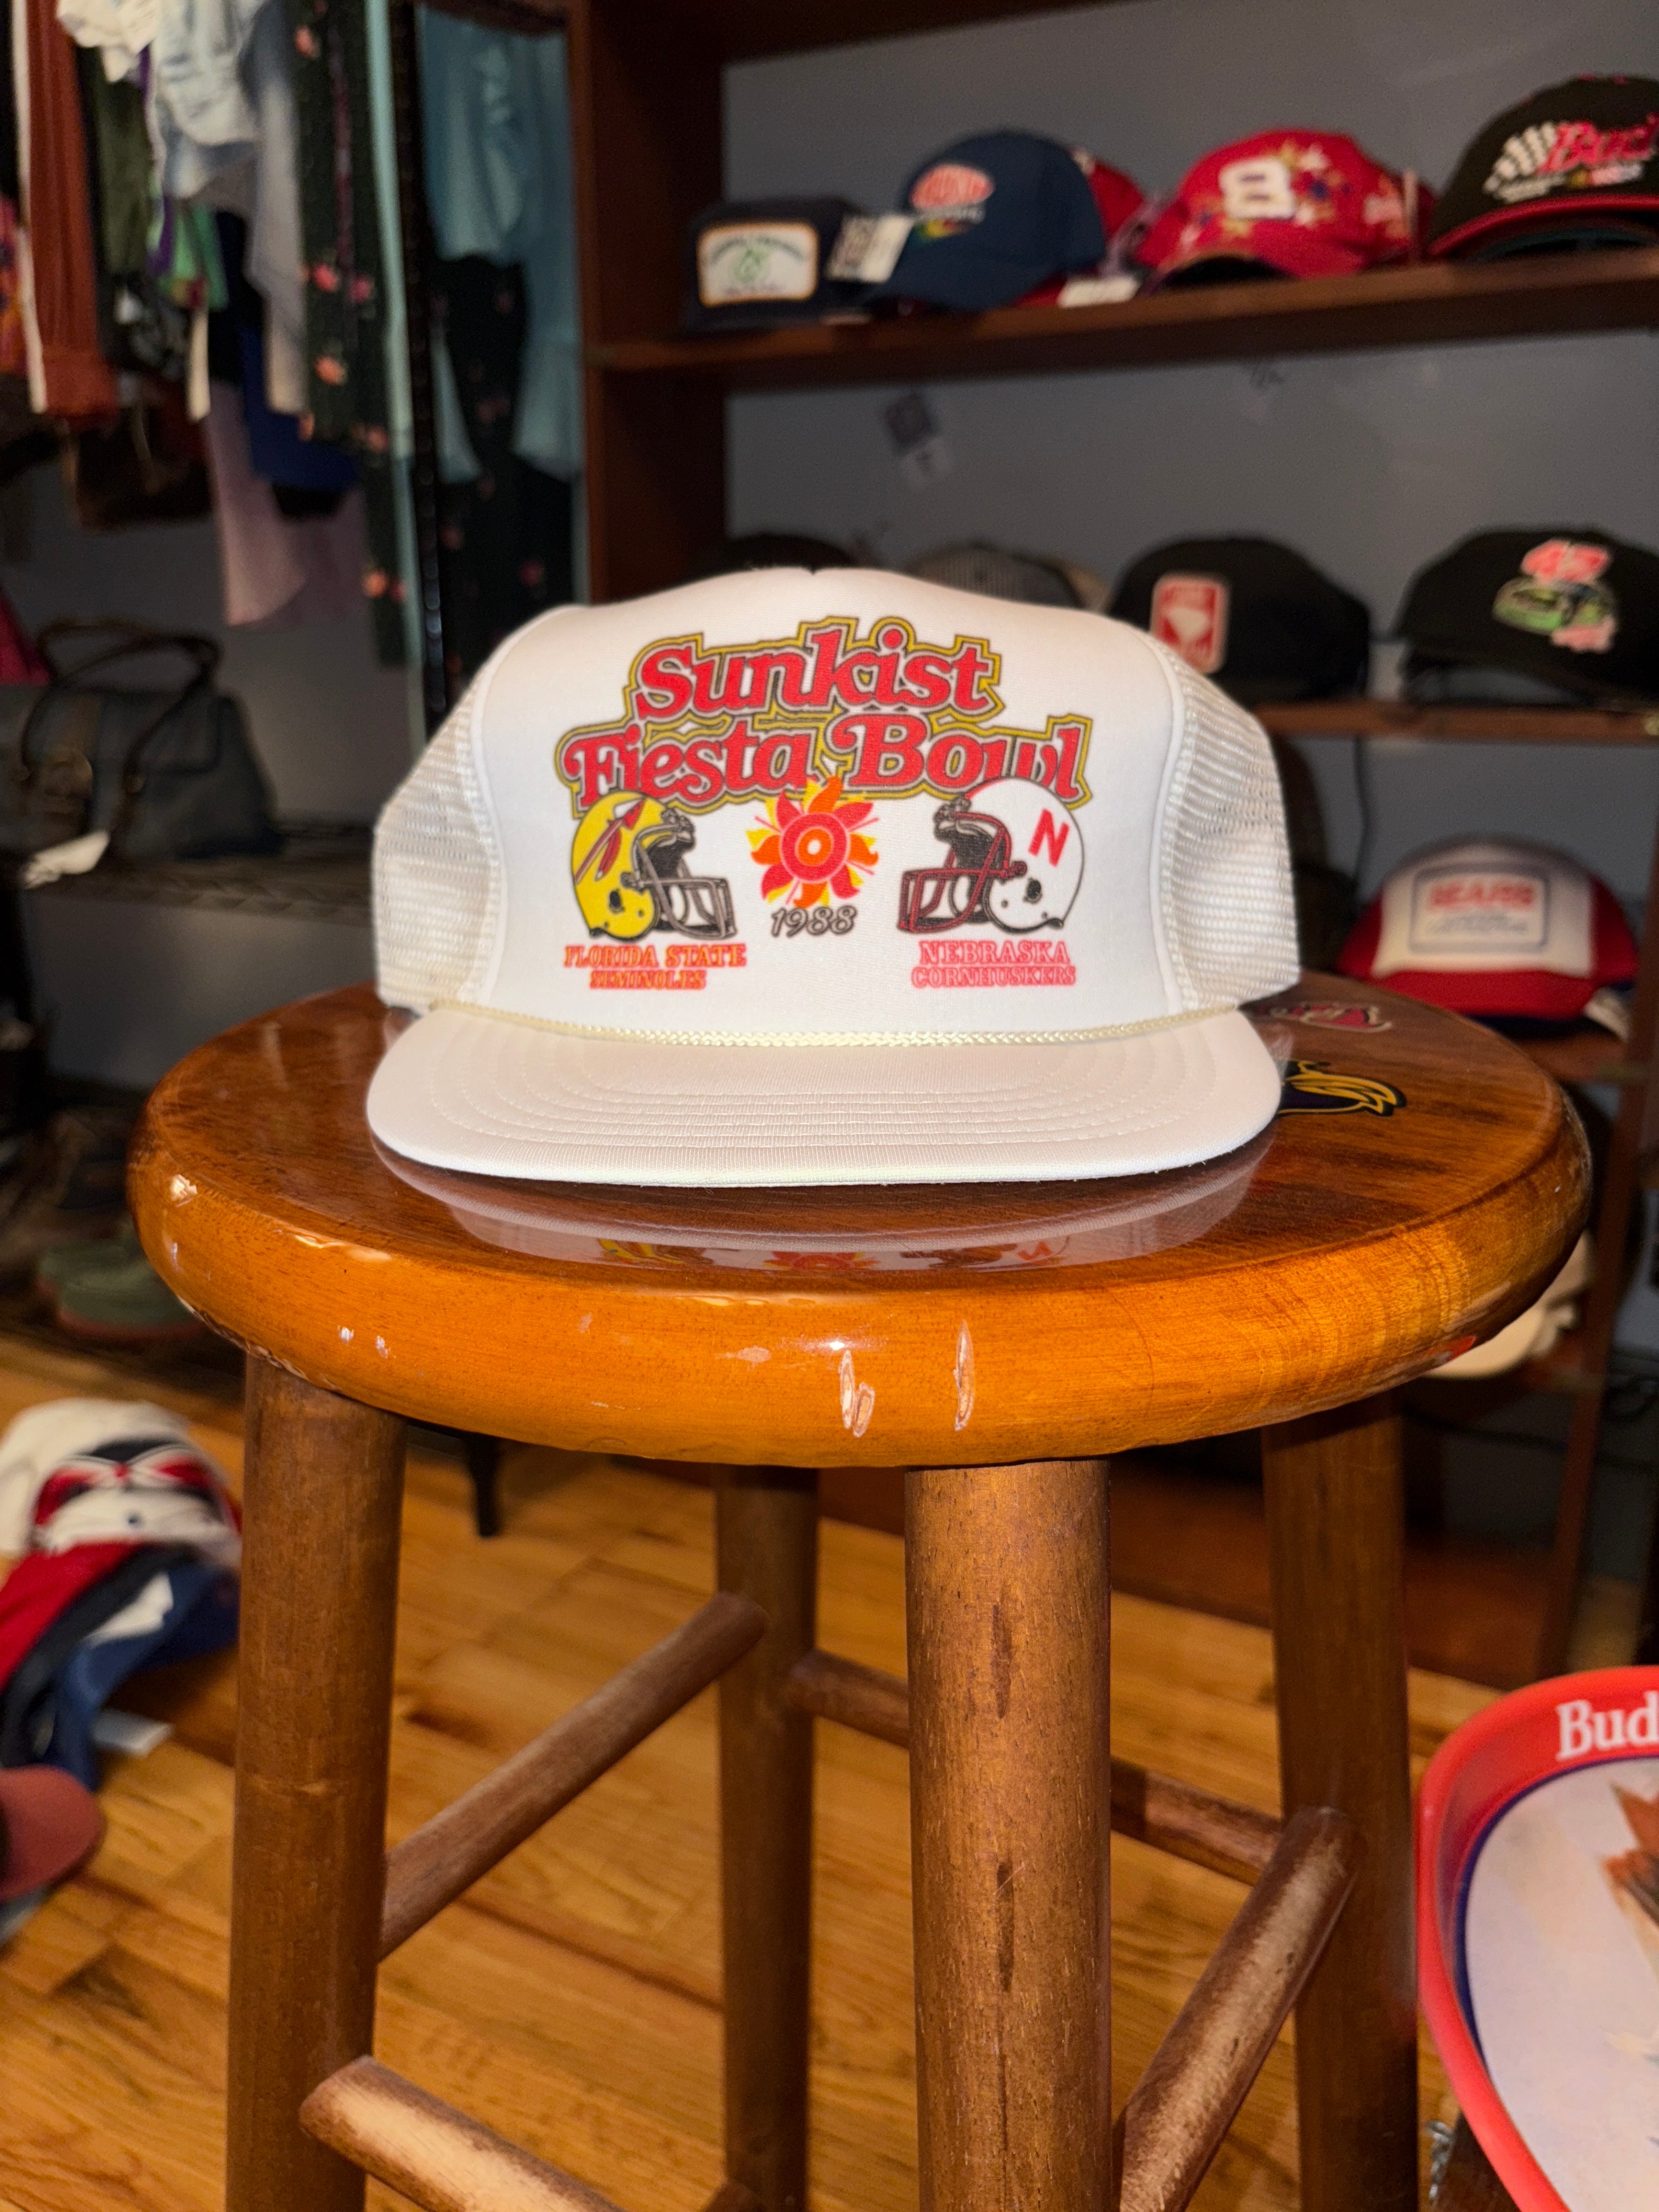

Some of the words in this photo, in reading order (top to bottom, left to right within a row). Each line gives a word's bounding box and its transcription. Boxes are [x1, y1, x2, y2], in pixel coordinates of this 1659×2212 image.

[633, 625, 991, 720] Sunkist
[561, 720, 820, 808] Fiesta
[828, 713, 1082, 799] Bowl
[1029, 809, 1070, 867] N
[771, 906, 857, 938] 1988
[563, 945, 659, 967] FLORIDA
[665, 943, 747, 967] STATE
[918, 940, 1070, 964] NEBRASKA
[590, 970, 707, 989] SEMINOLES
[911, 966, 1076, 988] CORNHUSKERS
[1555, 1690, 1659, 1762] Bud
